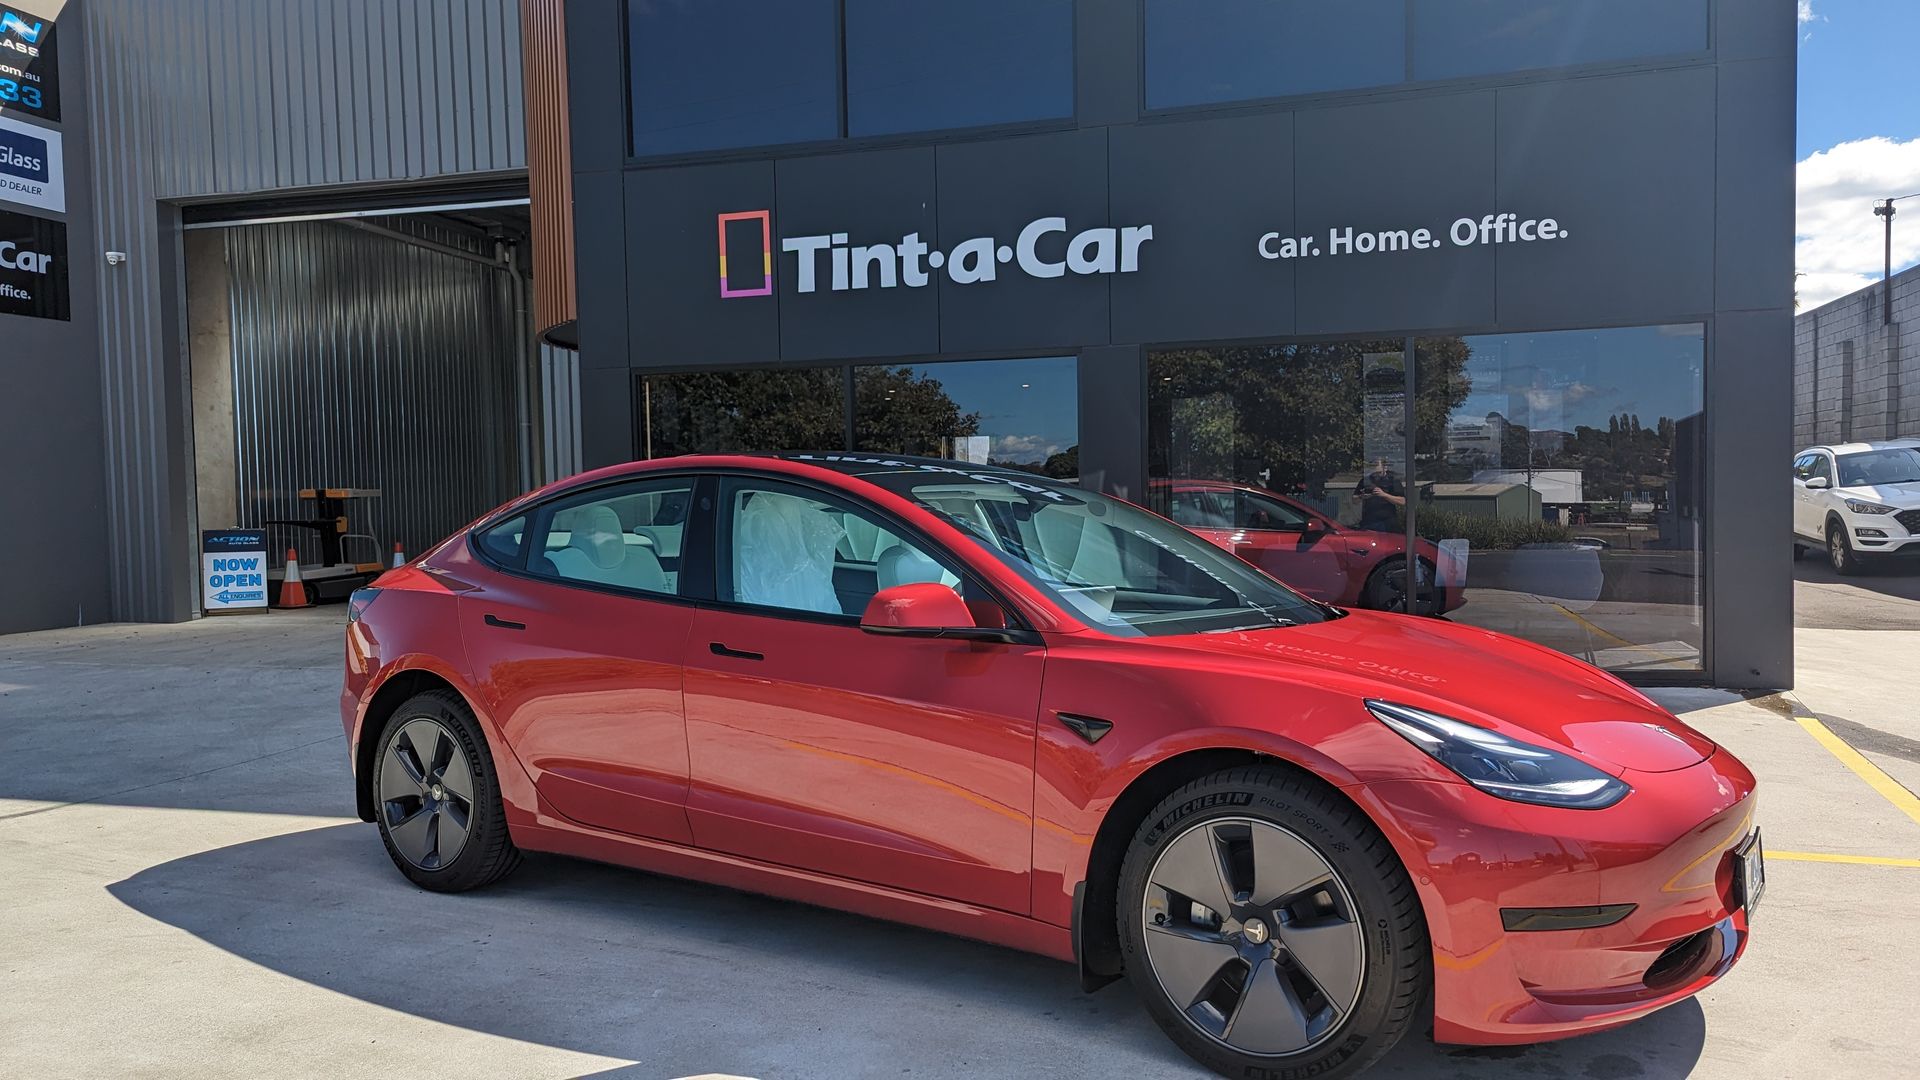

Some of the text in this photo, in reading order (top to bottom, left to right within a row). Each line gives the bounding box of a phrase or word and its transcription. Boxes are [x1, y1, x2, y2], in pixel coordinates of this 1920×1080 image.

[9, 181, 42, 196] DEALER
[1258, 213, 1568, 259] Car. Home. Office.
[213, 558, 258, 571] NOW
[209, 574, 262, 588] OPEN
[1161, 792, 1329, 835] MICHELIN PILOT SPORT
